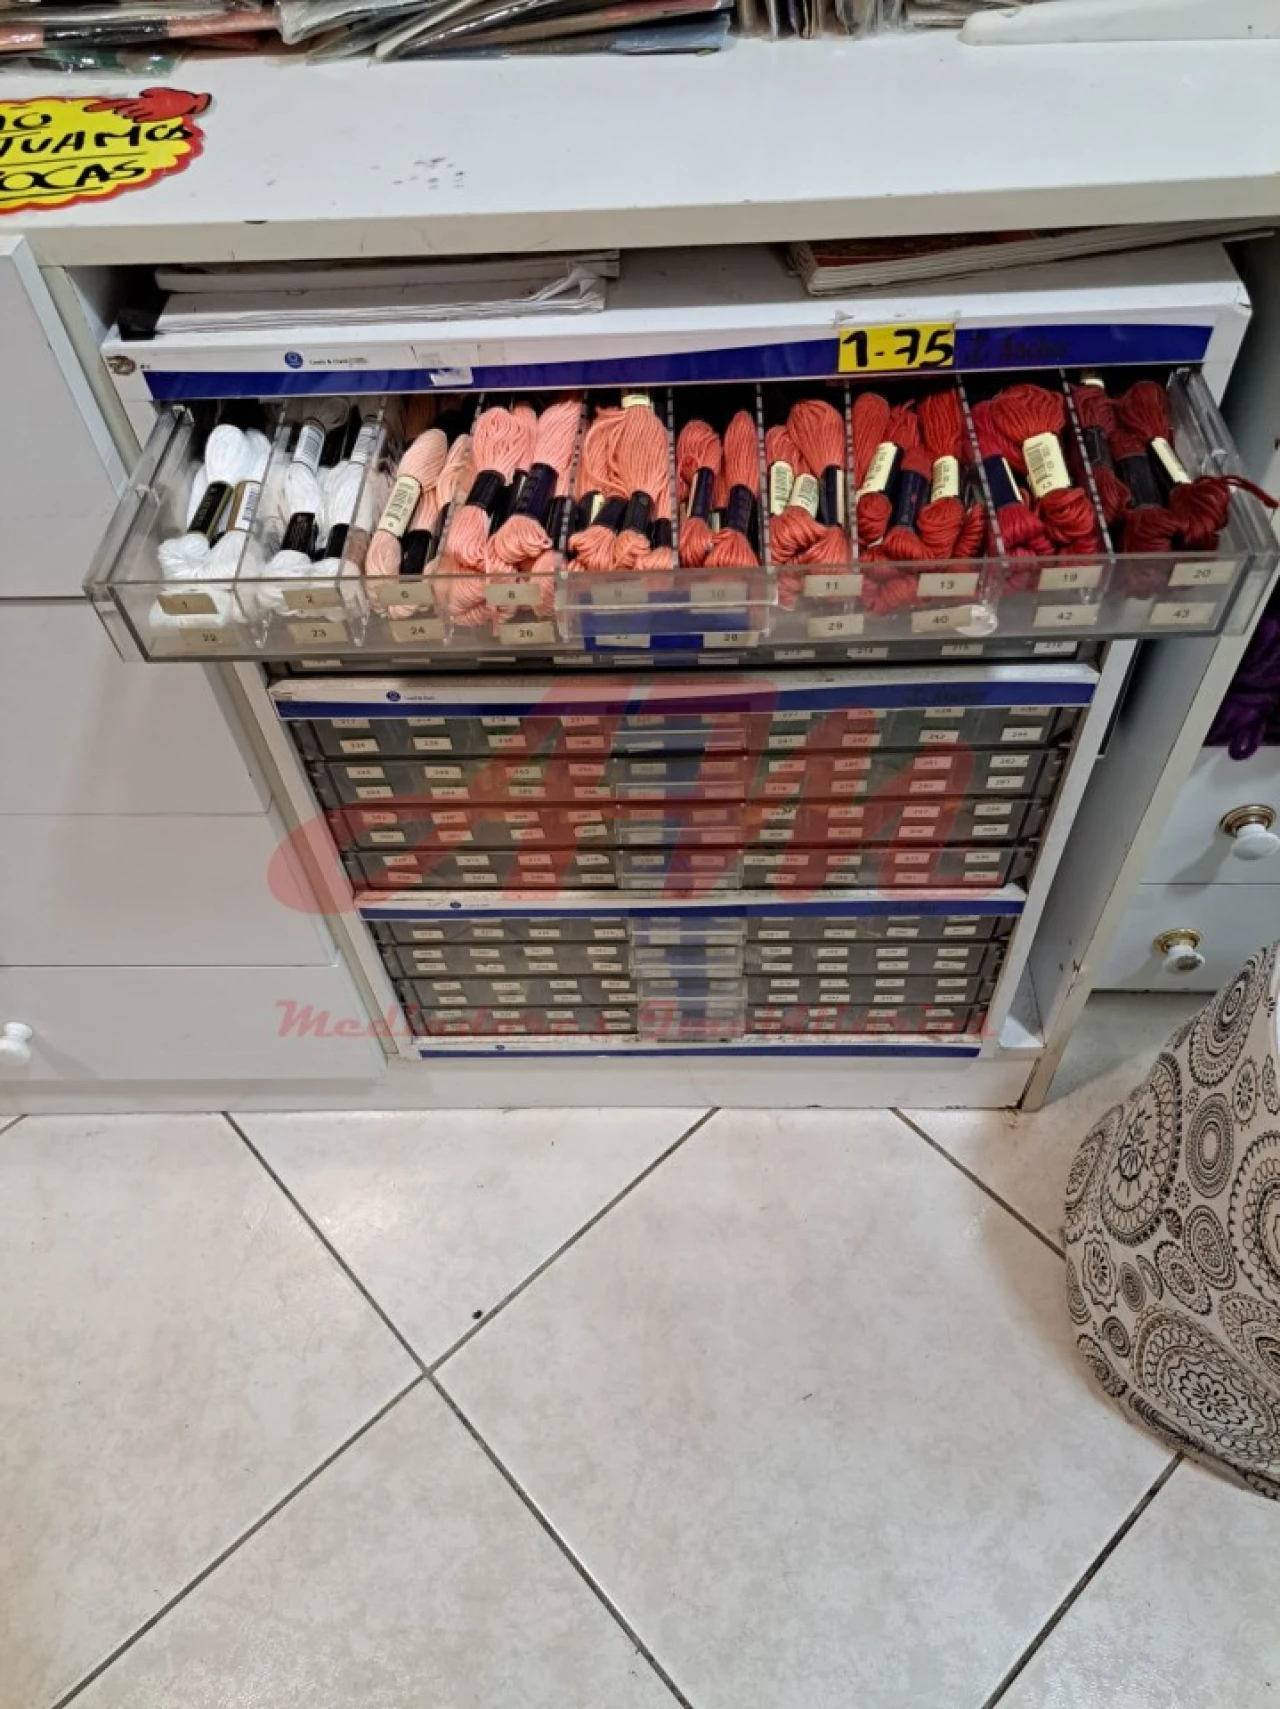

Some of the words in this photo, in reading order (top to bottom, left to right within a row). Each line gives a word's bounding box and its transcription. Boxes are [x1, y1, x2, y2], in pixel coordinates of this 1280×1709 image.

[0, 160, 145, 191] OCAS
[1193, 569, 1211, 579] 20
[825, 581, 839, 590] 11
[939, 581, 955, 590] 13
[1056, 611, 1073, 621] 42
[1172, 608, 1190, 618] 43
[932, 615, 950, 624] 40
[410, 626, 425, 635] 24
[827, 622, 843, 631] 29
[202, 633, 217, 642] 22
[311, 629, 327, 638] 23
